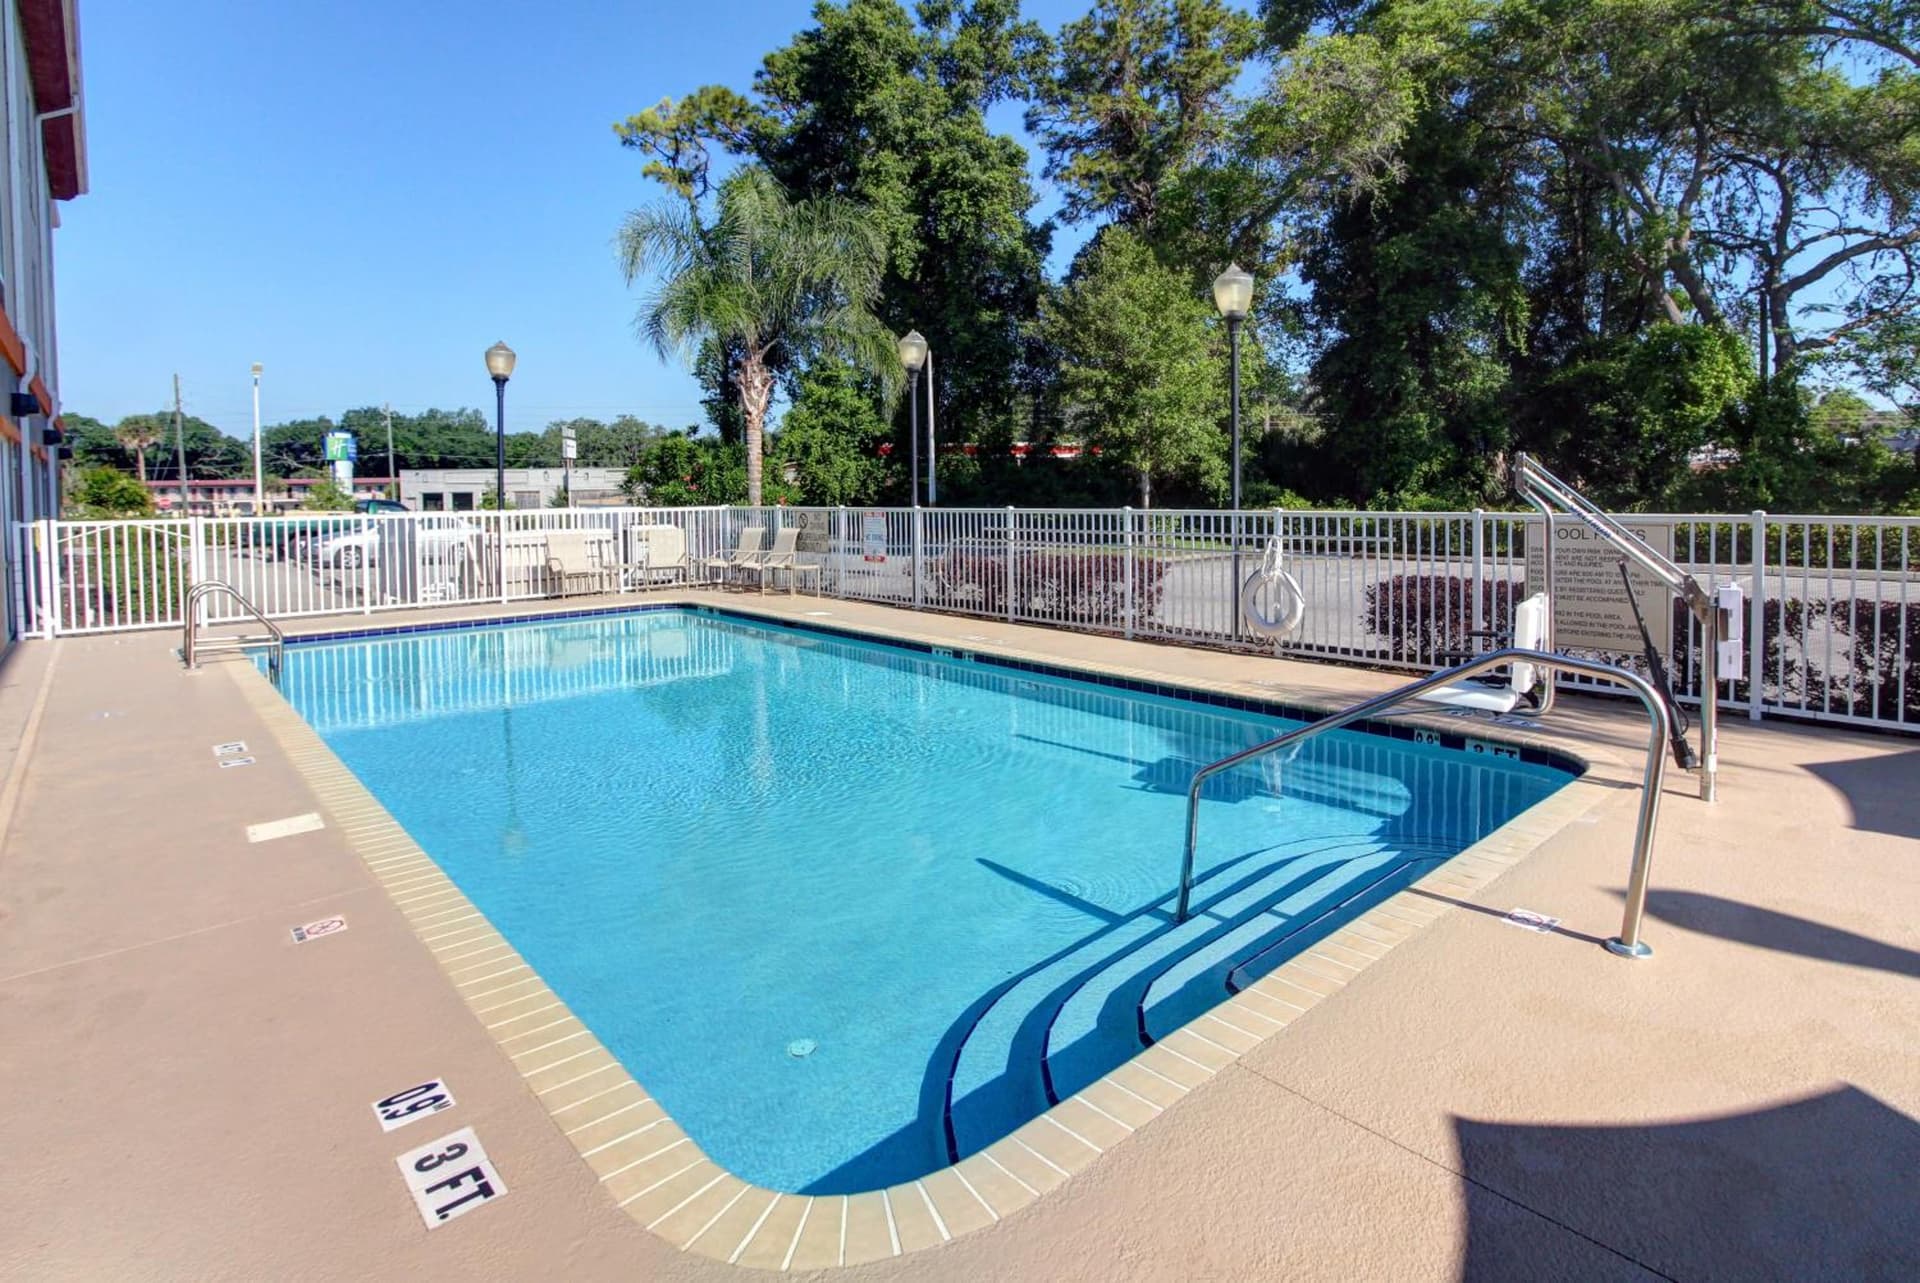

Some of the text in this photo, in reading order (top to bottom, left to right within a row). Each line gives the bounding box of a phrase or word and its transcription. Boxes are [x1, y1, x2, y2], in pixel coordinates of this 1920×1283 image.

[1554, 528, 1590, 540] OOL
[414, 1142, 495, 1220] 3 FT.
